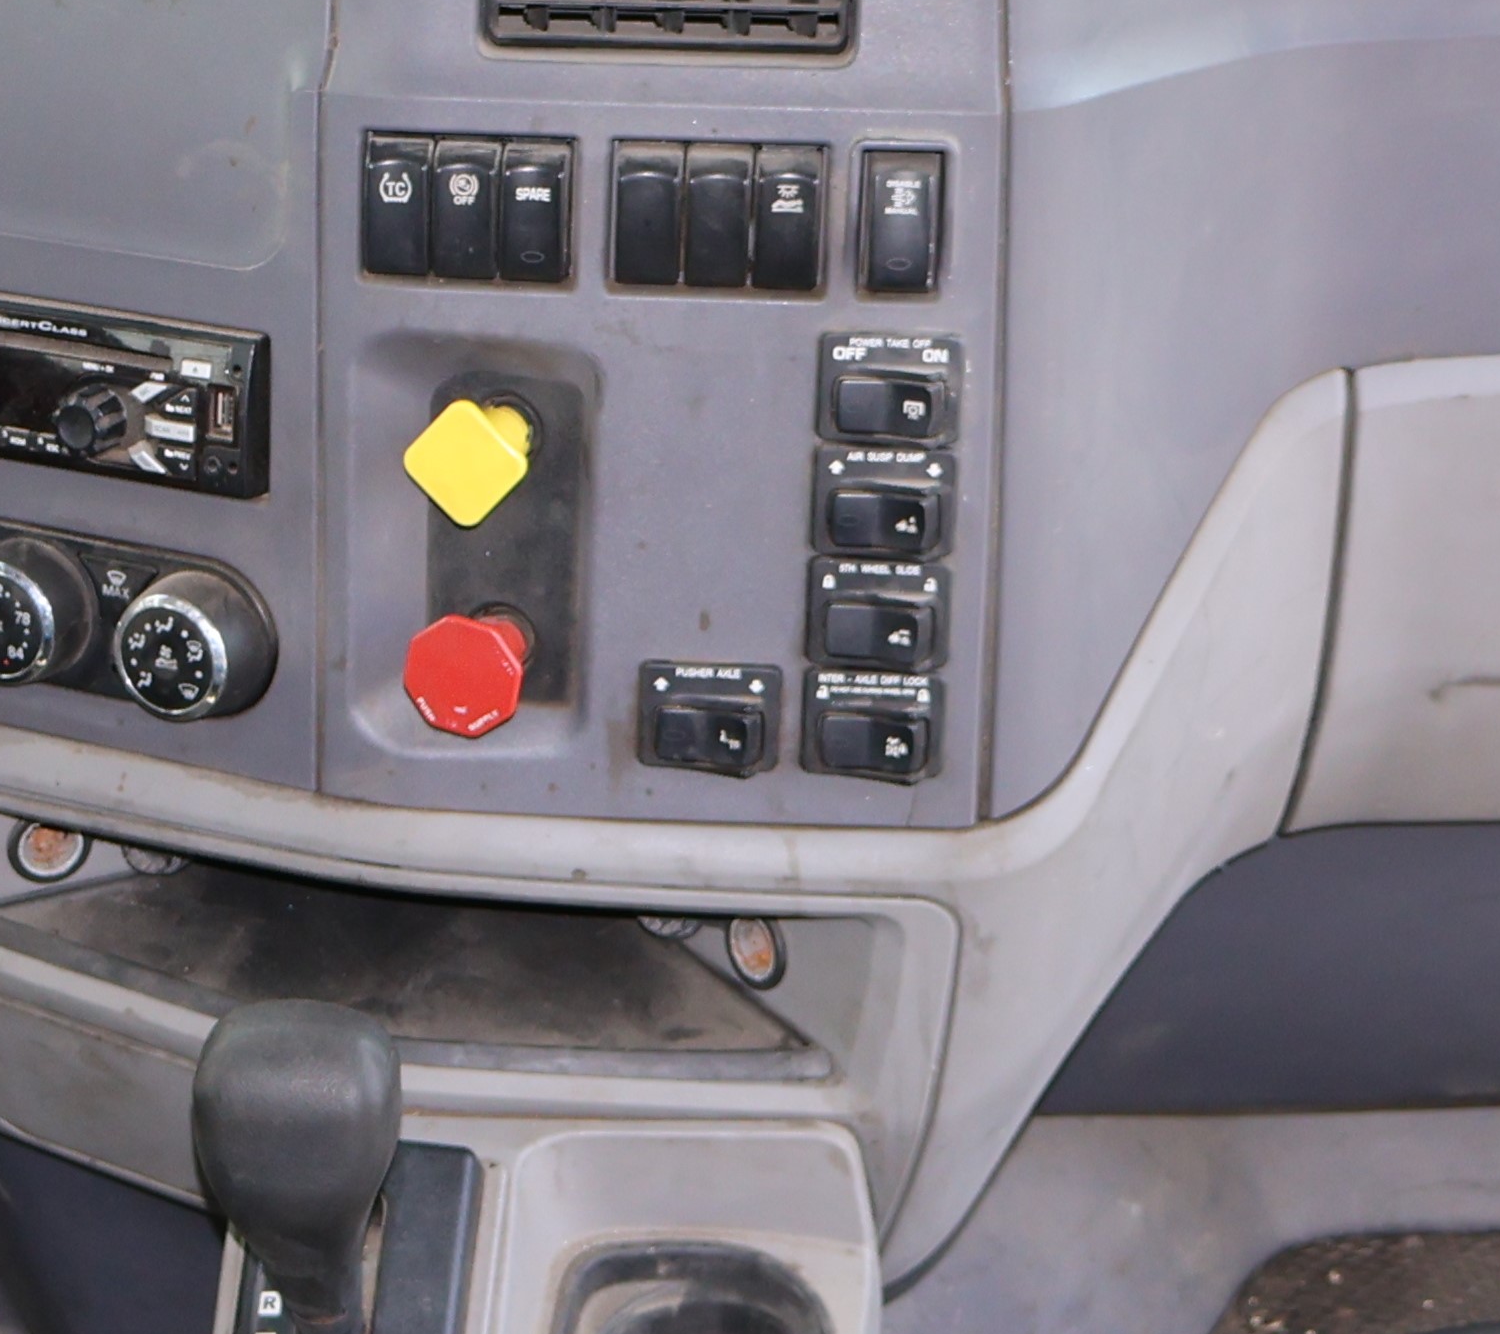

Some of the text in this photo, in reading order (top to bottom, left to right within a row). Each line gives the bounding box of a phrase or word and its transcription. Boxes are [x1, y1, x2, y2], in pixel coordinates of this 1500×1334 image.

[386, 181, 405, 197] TC
[515, 187, 552, 203] SPARE
[453, 195, 475, 206] OFF
[848, 338, 932, 349] POWER TAKE OFF
[832, 346, 949, 363] OFF ON
[847, 451, 926, 463] AIR SUSP DUMP
[861, 564, 891, 575] WHEEL
[102, 583, 130, 602] MAX
[15, 610, 31, 626] 78
[7, 644, 24, 660] 84
[675, 667, 742, 680] PUSHER AXLE
[818, 673, 845, 683] INTER
[854, 675, 877, 685] AXLE
[880, 675, 901, 685] DIFF
[903, 677, 928, 687] LOCK
